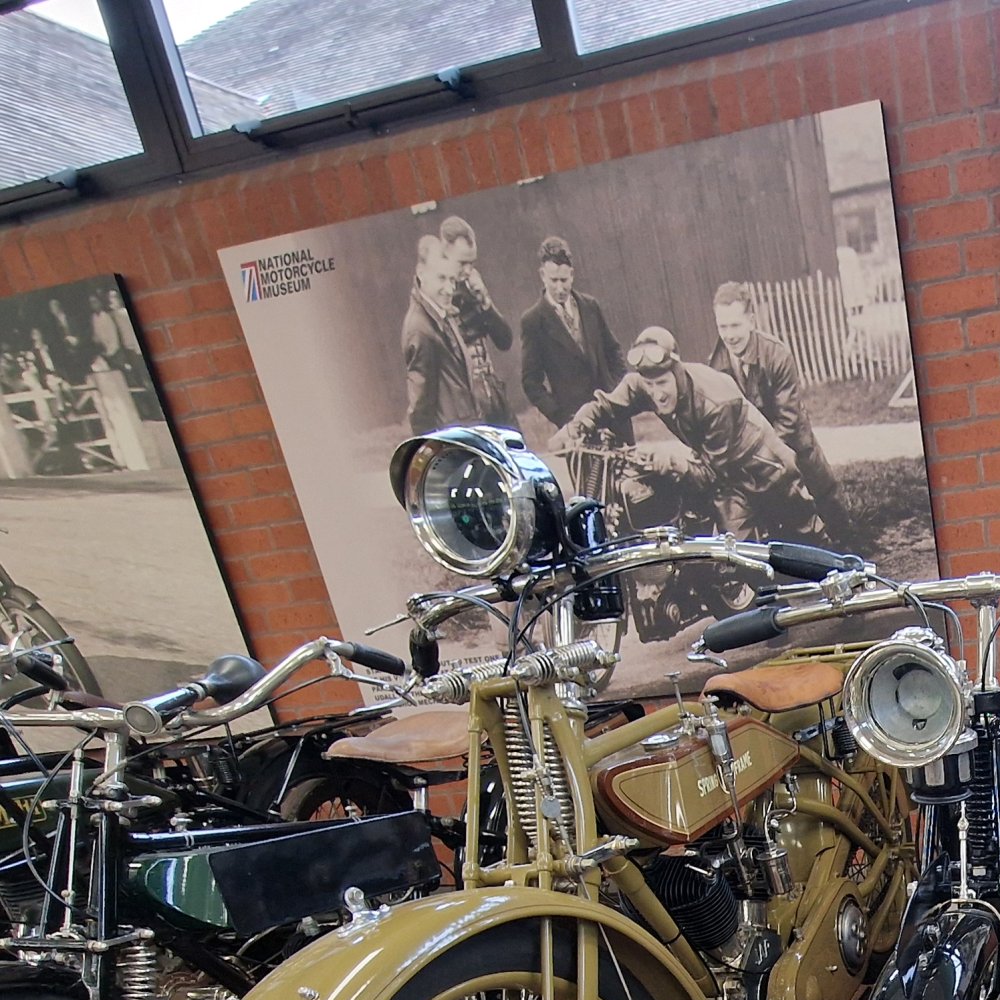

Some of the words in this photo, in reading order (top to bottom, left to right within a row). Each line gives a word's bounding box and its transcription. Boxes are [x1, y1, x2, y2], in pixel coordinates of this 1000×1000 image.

[258, 248, 314, 271] NATIONAL
[260, 258, 335, 285] MOTORCYCLE
[262, 277, 311, 299] MUSEUM
